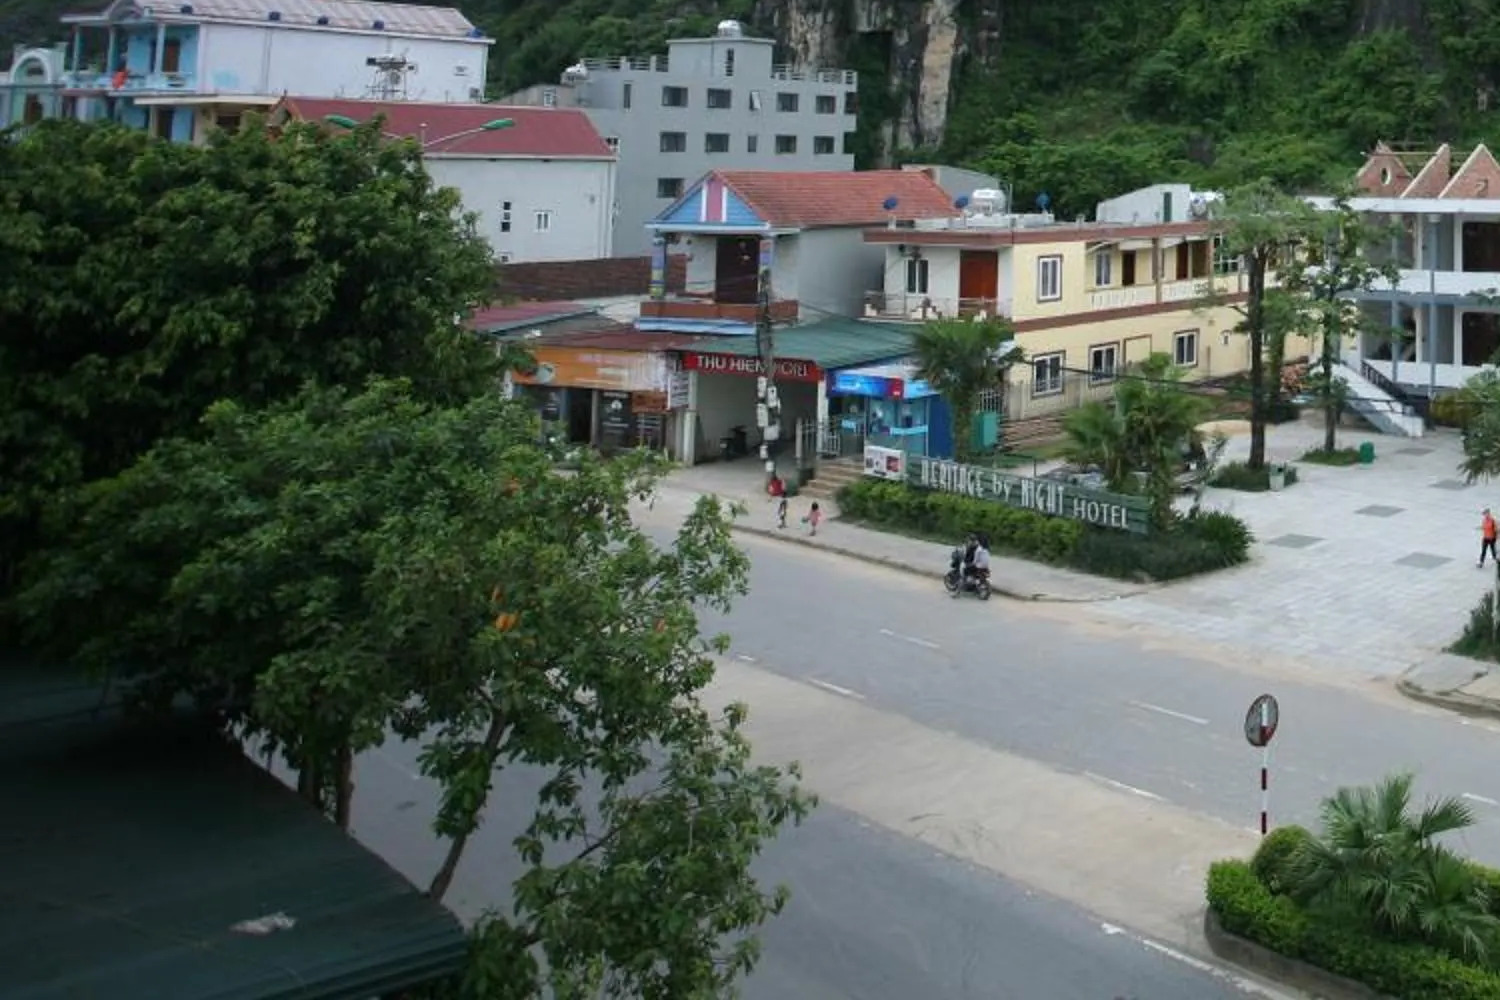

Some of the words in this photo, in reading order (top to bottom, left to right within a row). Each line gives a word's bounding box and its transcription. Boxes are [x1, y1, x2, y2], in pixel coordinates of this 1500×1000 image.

[921, 459, 984, 498] HERITAGE
[992, 472, 1012, 502] by
[1021, 478, 1064, 516] NIGHT
[1073, 496, 1129, 529] HOTEL
